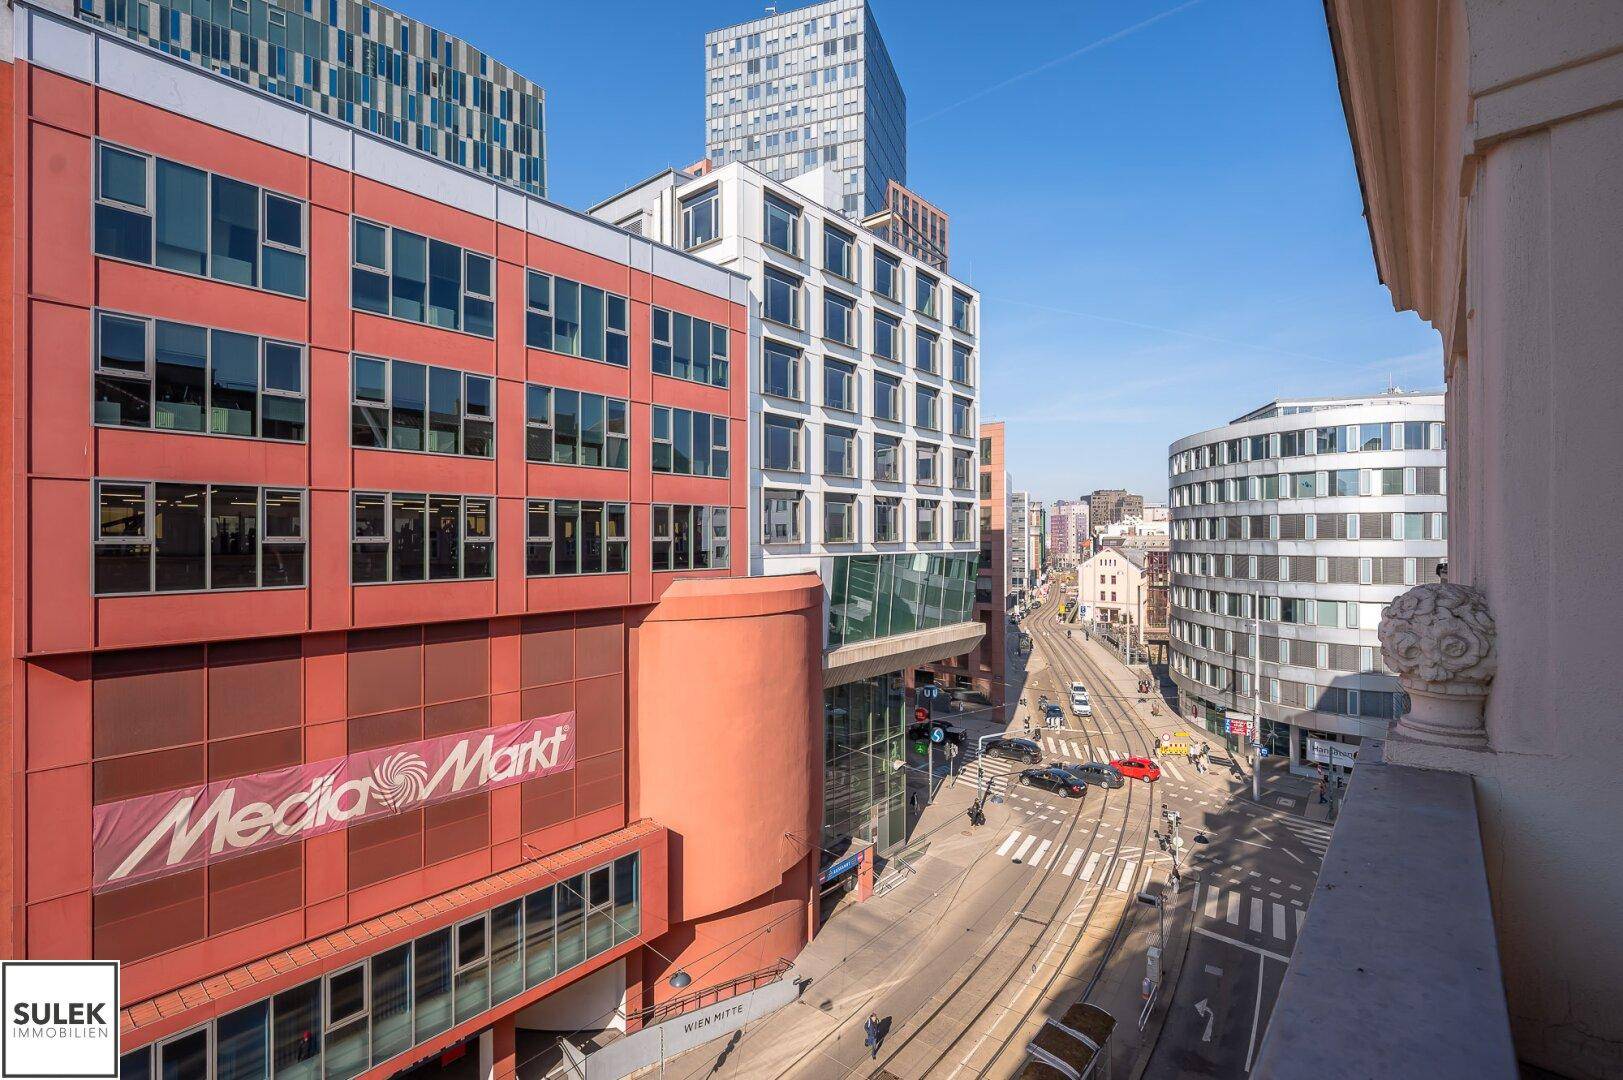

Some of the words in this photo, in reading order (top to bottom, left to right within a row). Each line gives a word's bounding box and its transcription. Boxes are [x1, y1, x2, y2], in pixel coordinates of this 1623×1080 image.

[924, 689, 930, 698] U
[932, 688, 938, 698] U
[107, 774, 374, 881] Media
[684, 1016, 711, 1033] WIEN
[714, 1004, 744, 1022] MITTE
